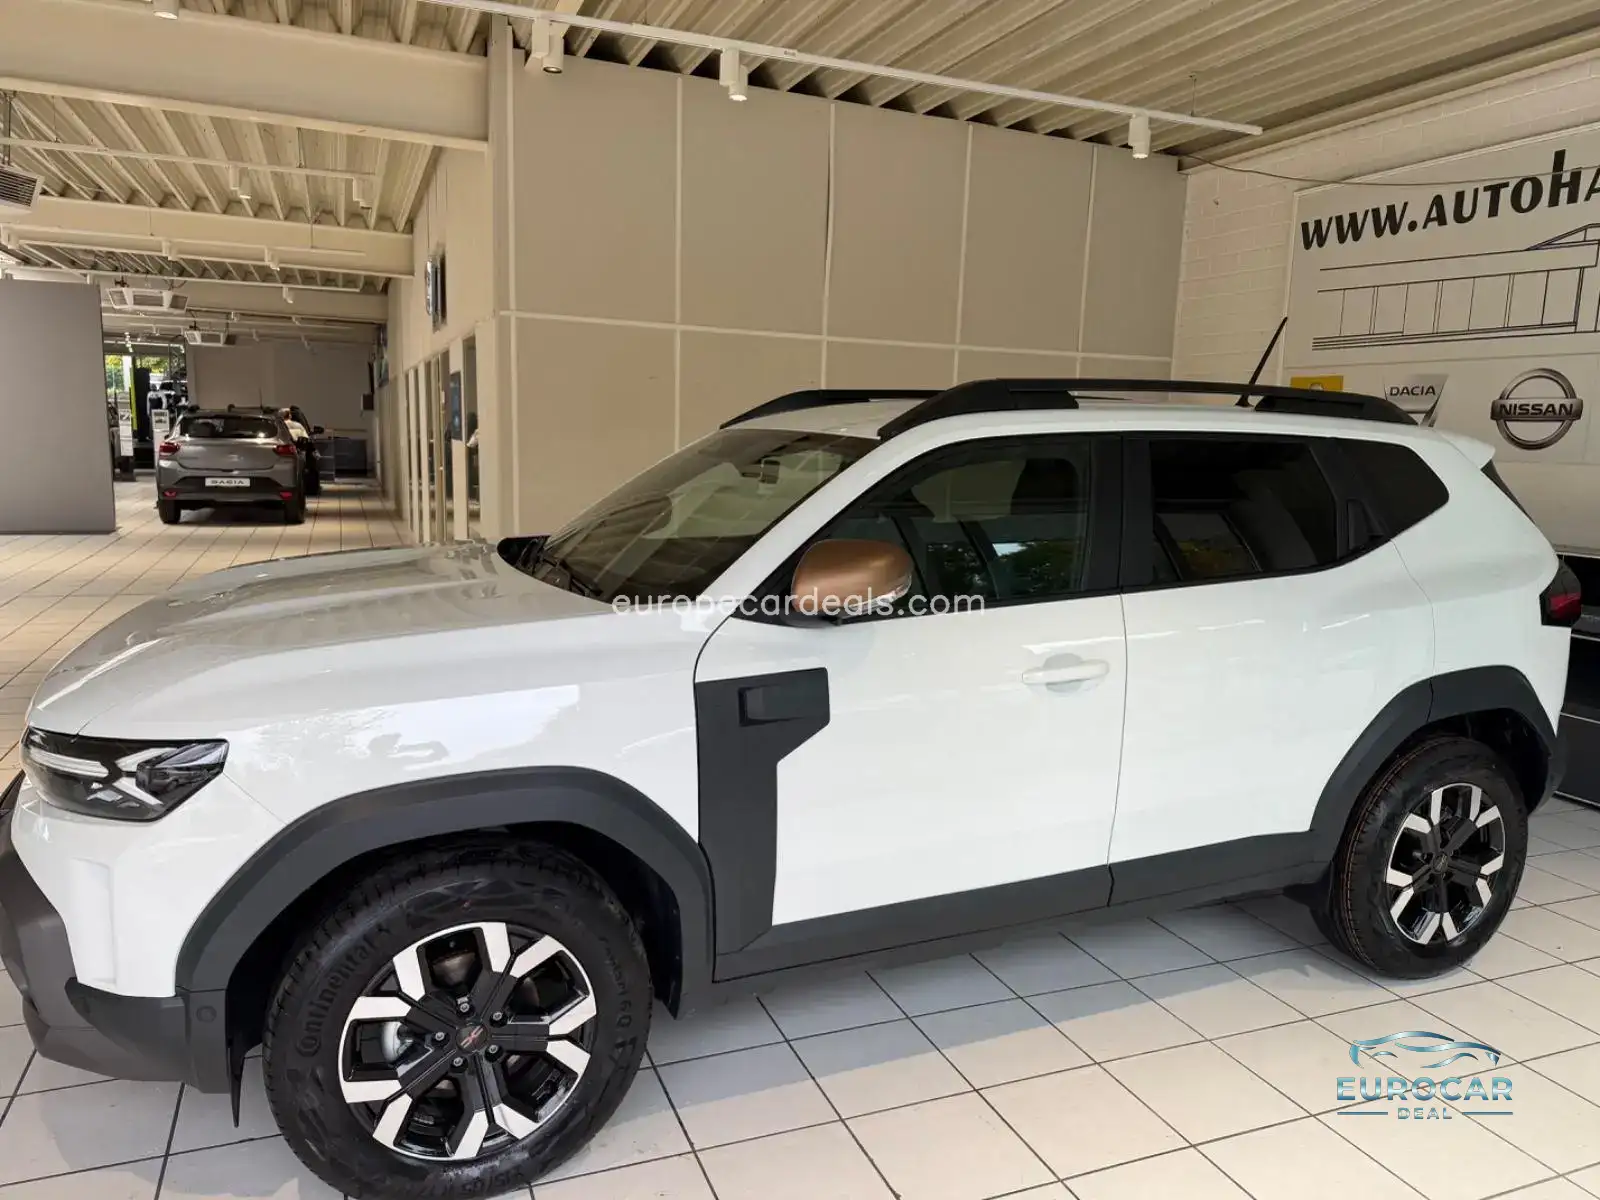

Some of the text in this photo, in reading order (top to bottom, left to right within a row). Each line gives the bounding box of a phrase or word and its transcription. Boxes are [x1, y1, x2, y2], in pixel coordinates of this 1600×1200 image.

[1389, 384, 1437, 397] DACIA
[1500, 402, 1574, 417] NISSAN
[296, 933, 378, 1057] Continental
